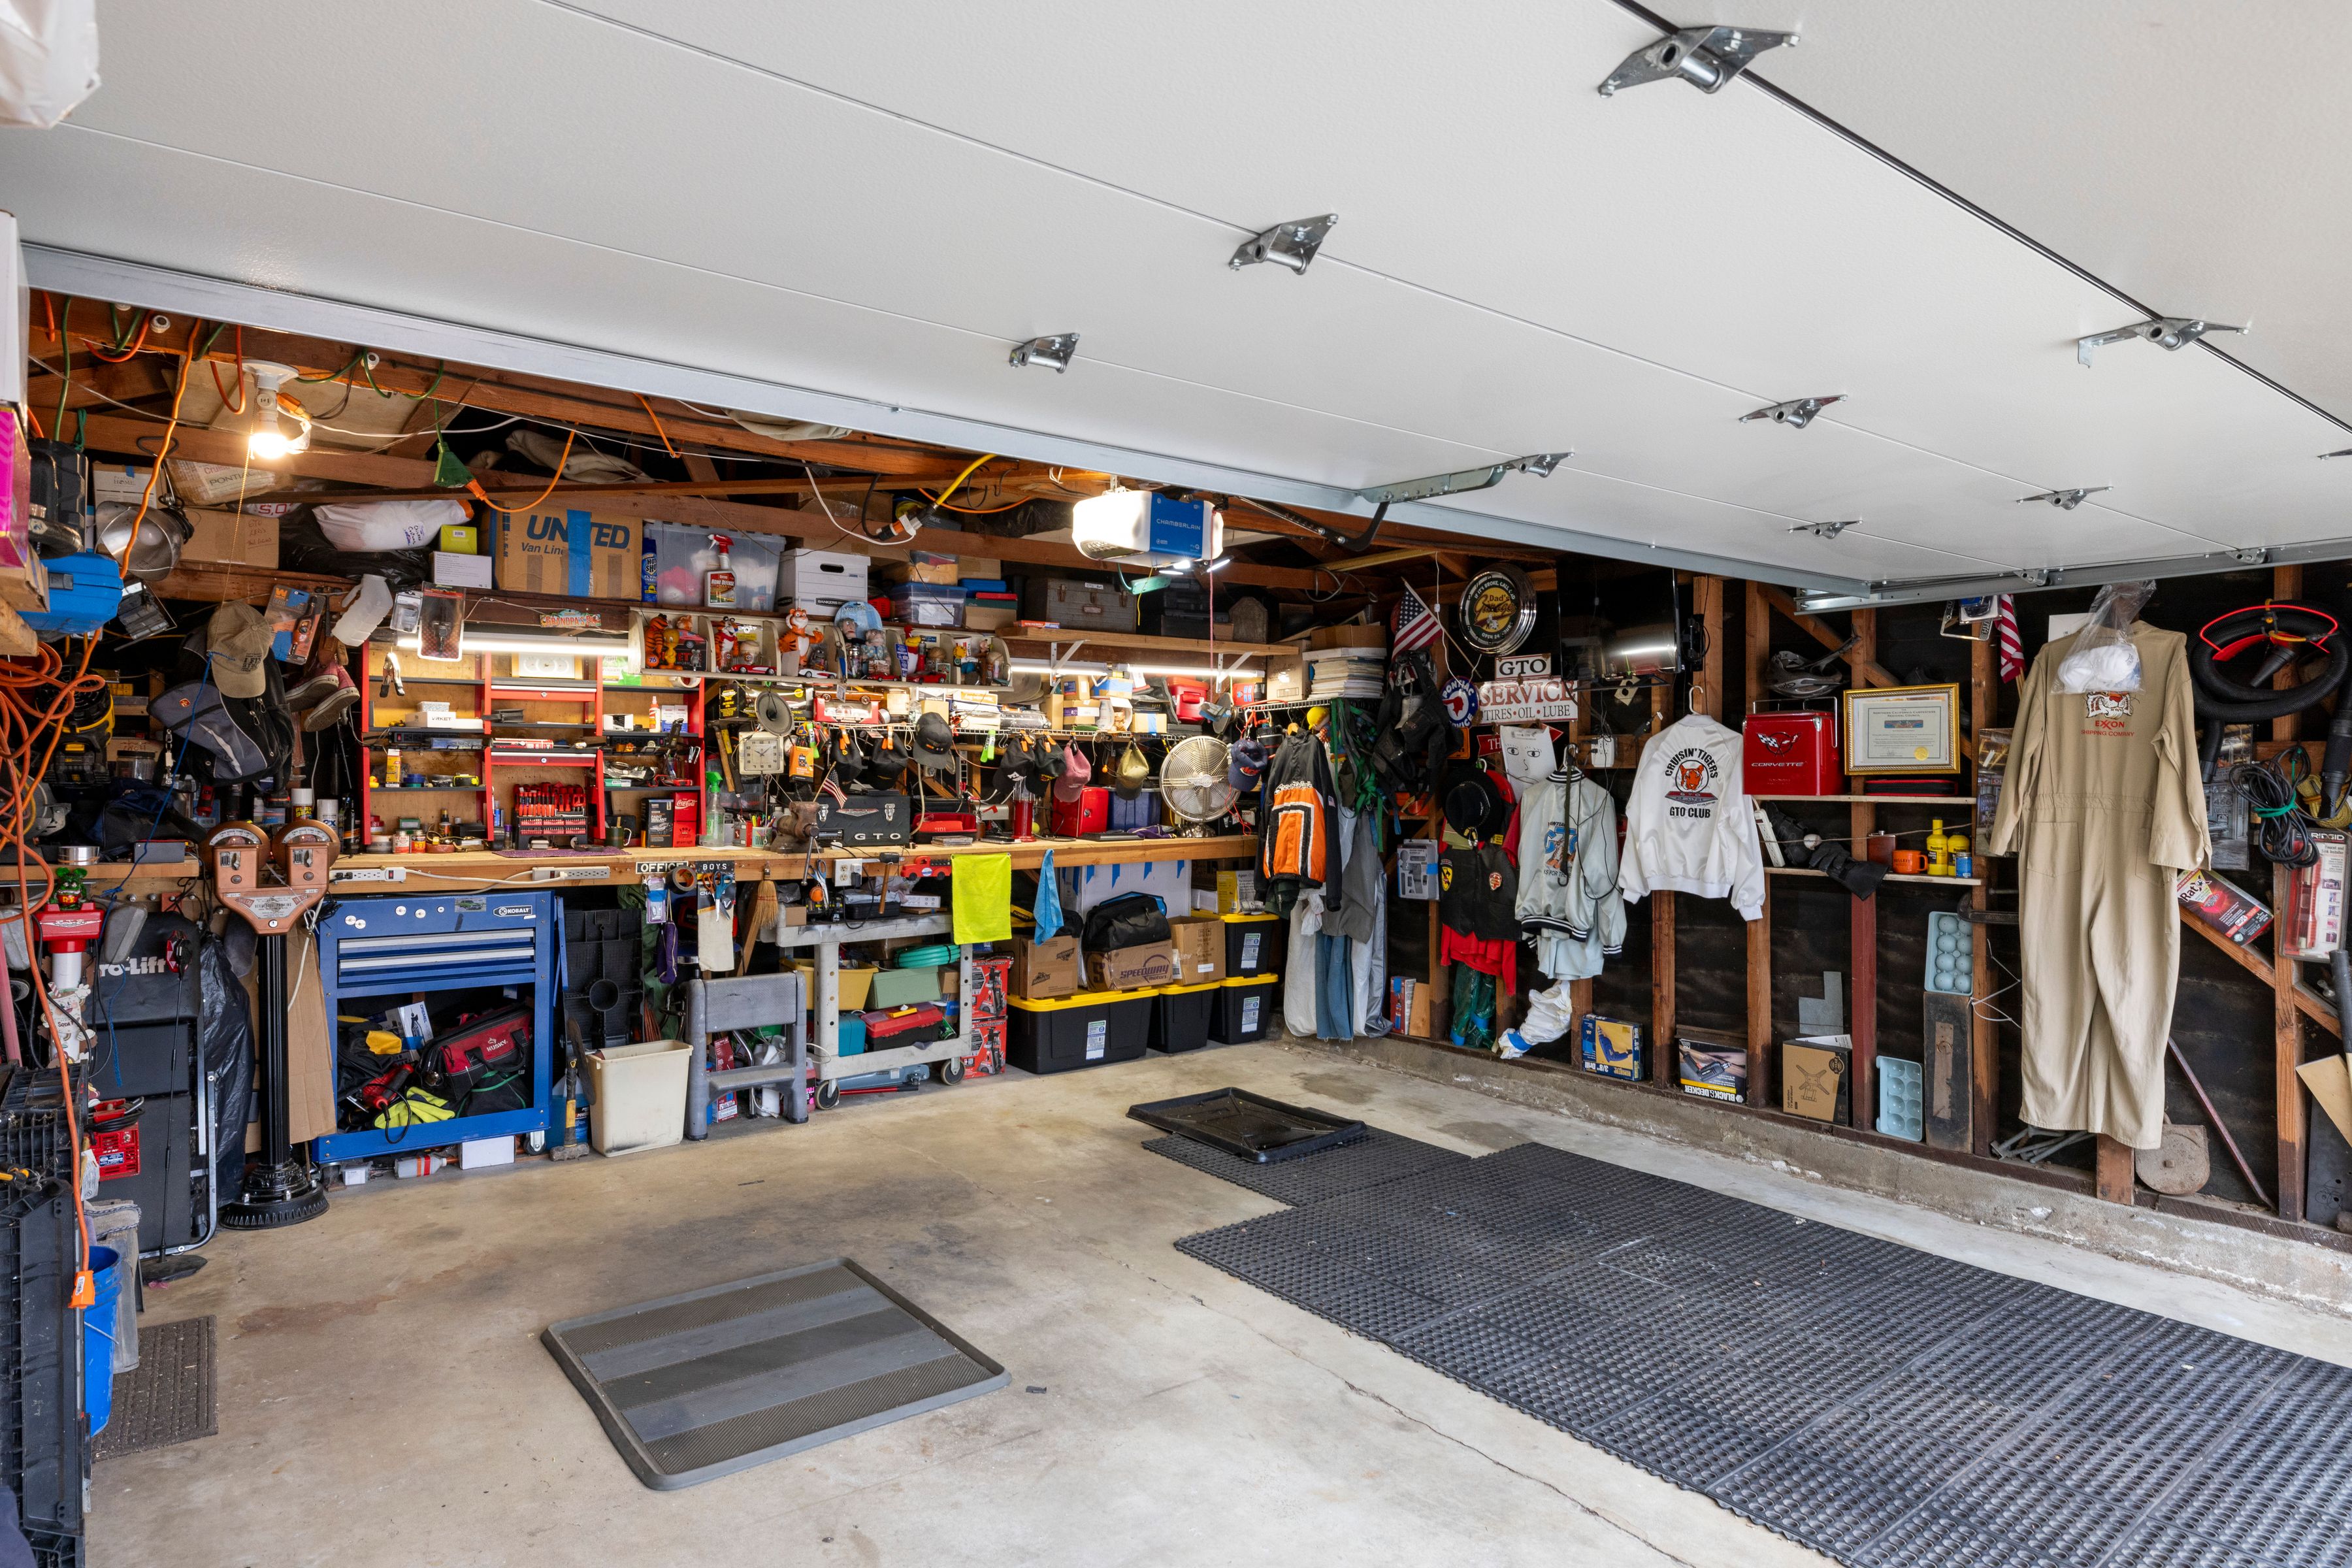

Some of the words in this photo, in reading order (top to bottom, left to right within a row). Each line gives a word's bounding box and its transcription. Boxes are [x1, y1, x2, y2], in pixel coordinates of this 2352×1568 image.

[527, 515, 630, 549] UNTED
[1156, 519, 1200, 531] CHAMBERLAIN
[522, 542, 541, 552] Van
[1499, 658, 1547, 676] GTO
[1442, 678, 1475, 698] PONTIAC
[1478, 680, 1578, 707] SERVICE
[1484, 708, 1512, 721] TIRES
[1518, 706, 1535, 719] OIL
[1543, 704, 1571, 718] LUBE
[2095, 719, 2125, 730] EXXON
[1665, 748, 1697, 777] CRUISIN'
[1697, 748, 1718, 779] TIGERS
[676, 798, 698, 809] Coca-Cola
[1669, 806, 1686, 817] GTO
[1688, 808, 1711, 819] CLUB
[2311, 832, 2345, 841] RIDGID
[99, 956, 166, 977] ro-Lift
[1120, 964, 1169, 979] SPEEDWAY
[486, 1039, 507, 1052] HUSKY
[1585, 1061, 1596, 1071] Drill
